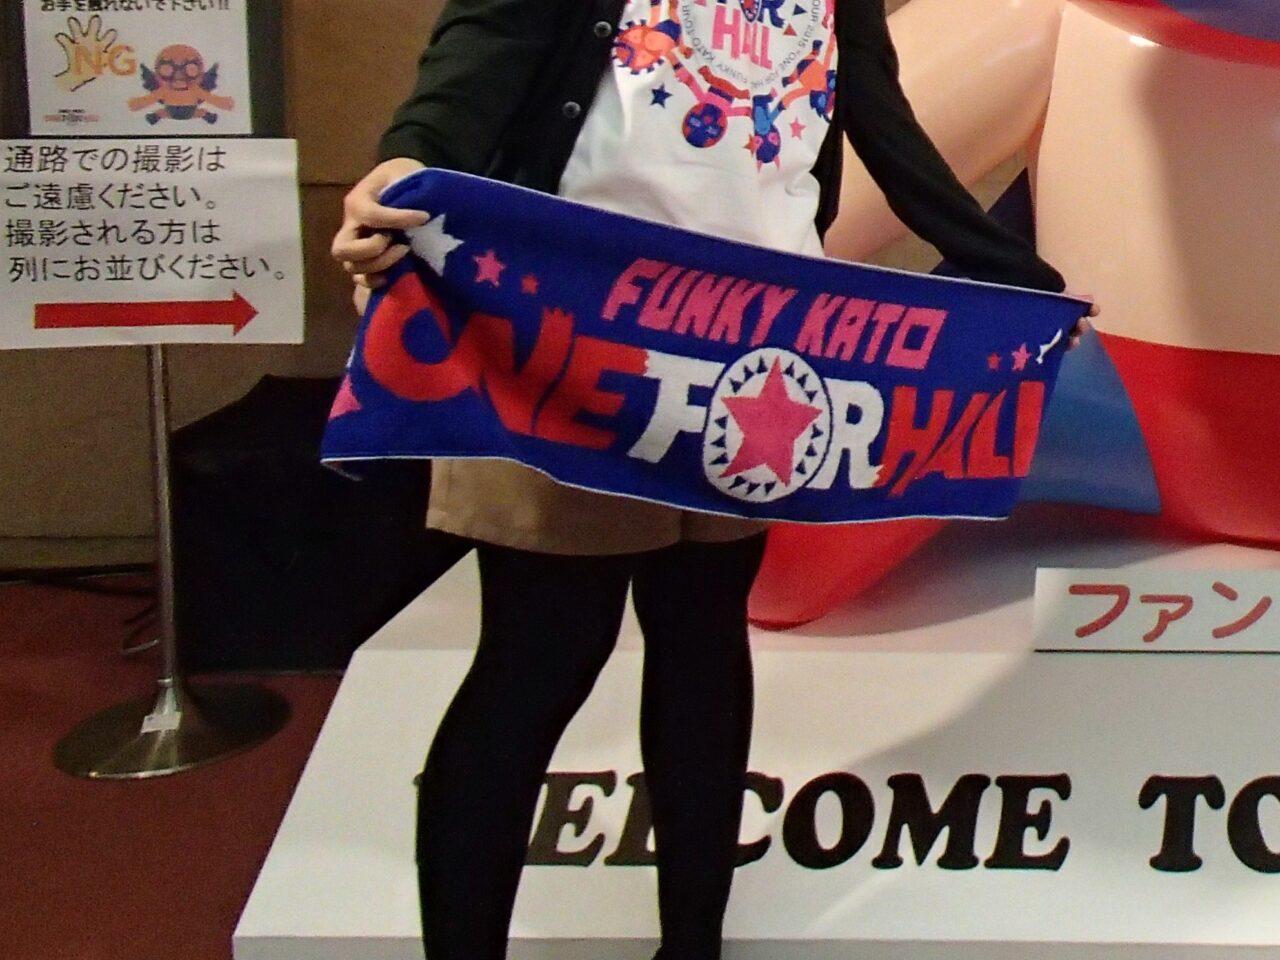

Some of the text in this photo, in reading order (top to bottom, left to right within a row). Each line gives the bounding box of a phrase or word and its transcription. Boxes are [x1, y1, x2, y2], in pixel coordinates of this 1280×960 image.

[73, 43, 139, 77] NG
[3, 144, 228, 173] 通路での撮影は
[4, 182, 217, 211] ご遠慮ください。
[5, 218, 222, 247] 撮影される方は
[8, 253, 288, 282] 列にお並びください。
[602, 257, 949, 371] FUNKY KATO
[413, 770, 1073, 873] ELCOME
